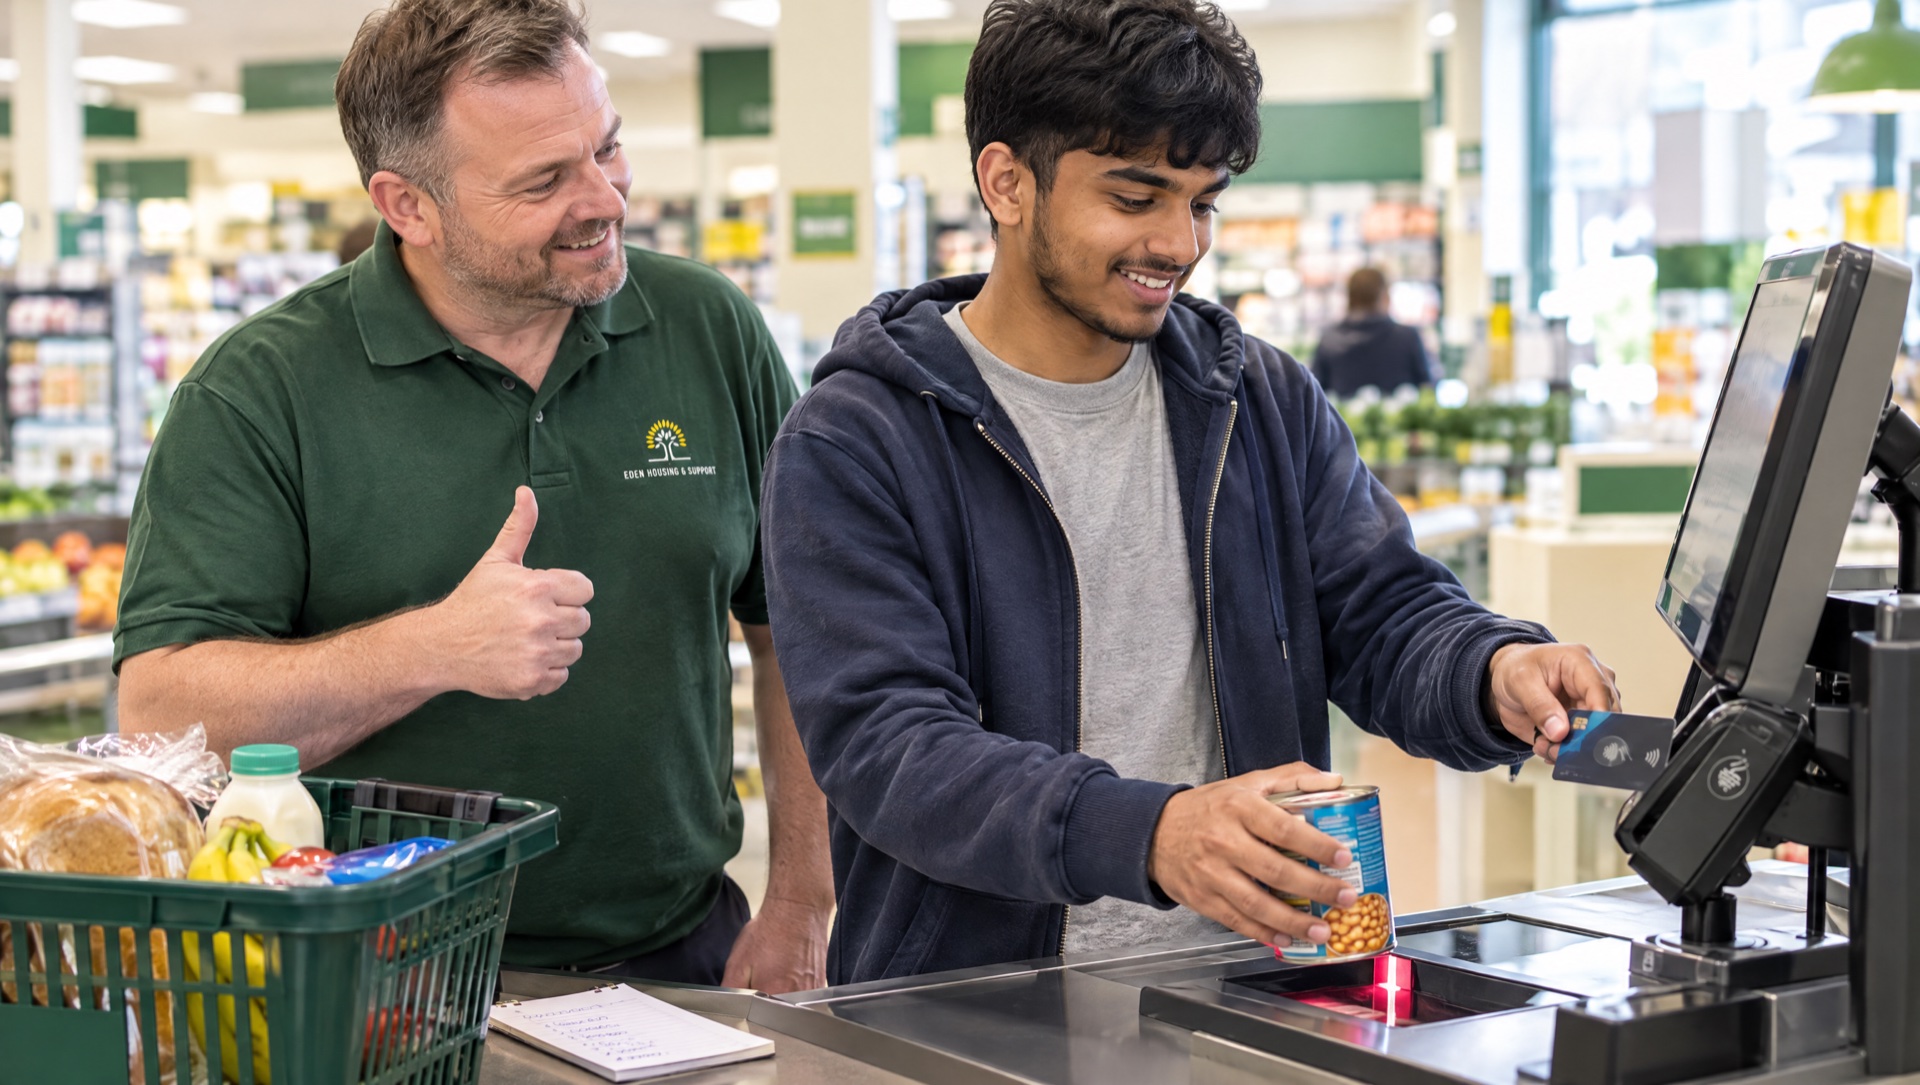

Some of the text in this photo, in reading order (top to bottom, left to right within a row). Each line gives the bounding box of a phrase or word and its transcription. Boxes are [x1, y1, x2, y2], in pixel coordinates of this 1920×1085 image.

[624, 466, 716, 480] EDEN HOUSING & SUPPORT
